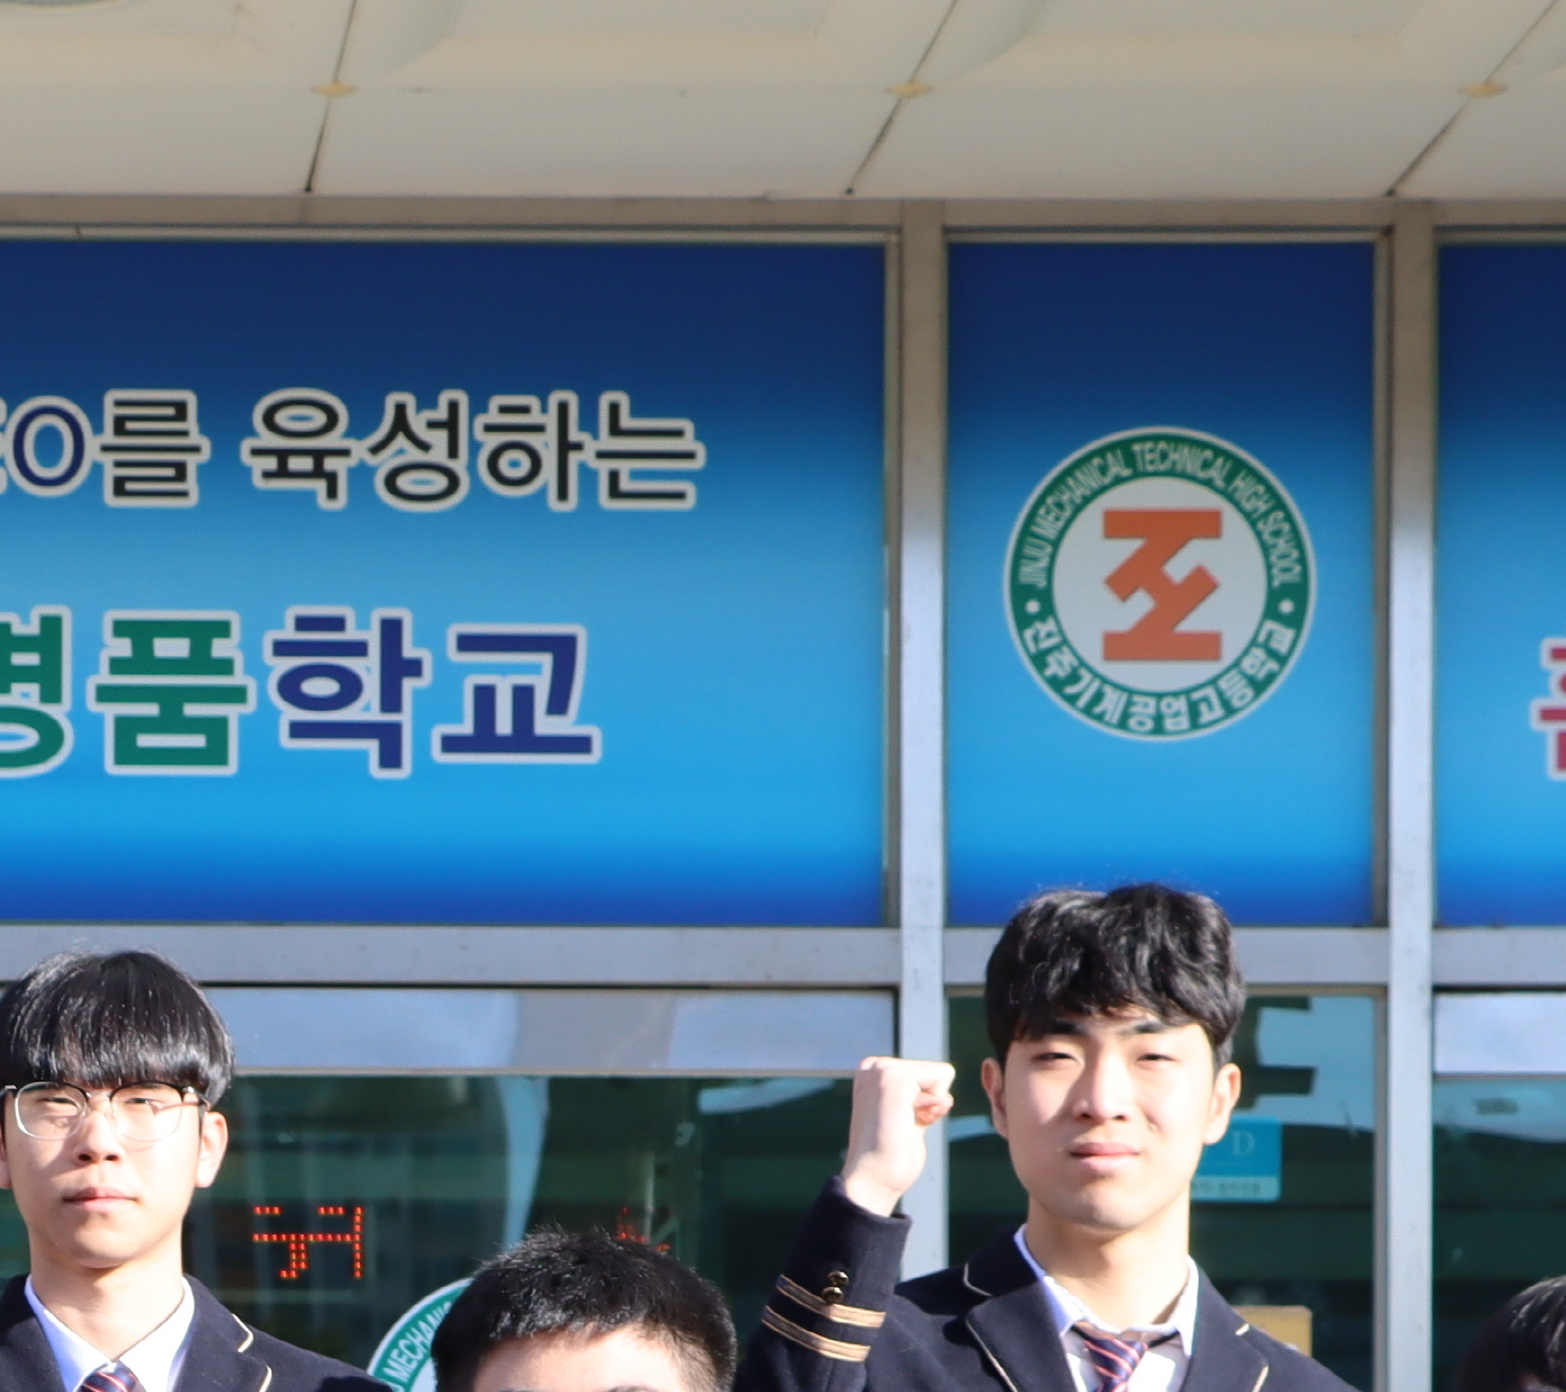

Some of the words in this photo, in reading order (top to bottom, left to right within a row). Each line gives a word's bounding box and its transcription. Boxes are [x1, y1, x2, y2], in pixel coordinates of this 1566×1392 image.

[241, 389, 705, 511] 육성하는
[1030, 448, 1133, 540] MECHANICAL
[1132, 441, 1232, 488] TECHNICAL
[1228, 469, 1276, 519] HIGH
[1256, 510, 1302, 588] SCHOOL
[1022, 616, 1297, 732] 진주기계공업고등학교
